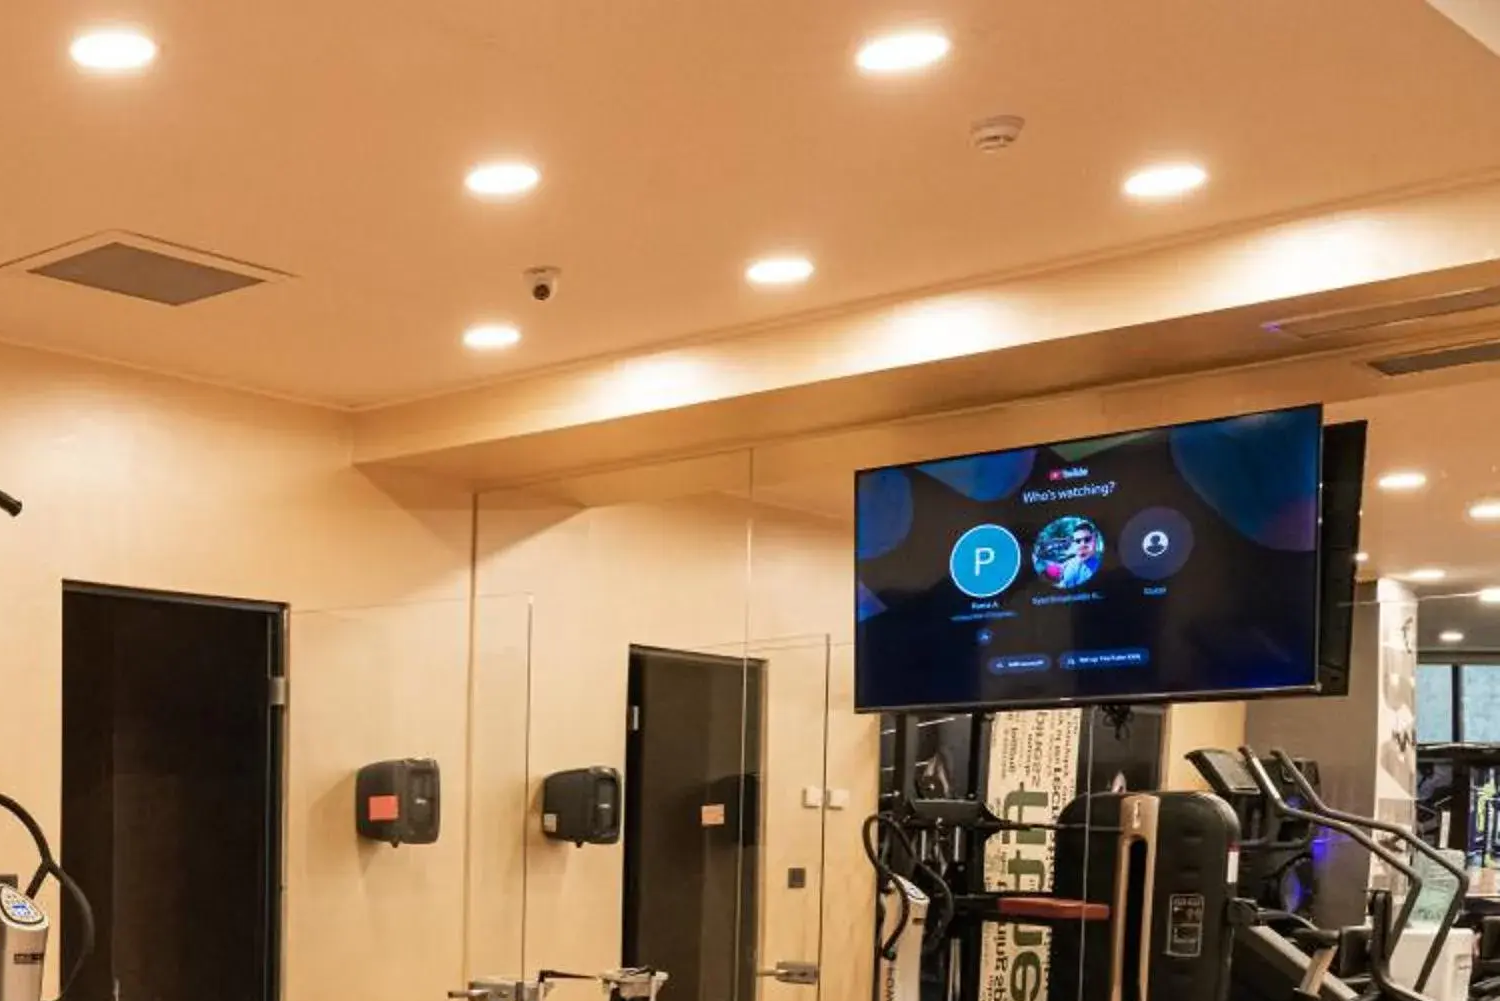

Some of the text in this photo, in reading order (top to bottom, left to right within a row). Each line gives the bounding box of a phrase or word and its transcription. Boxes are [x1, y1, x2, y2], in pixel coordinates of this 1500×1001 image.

[1023, 481, 1116, 505] Who's watching?
[974, 547, 995, 577] P
